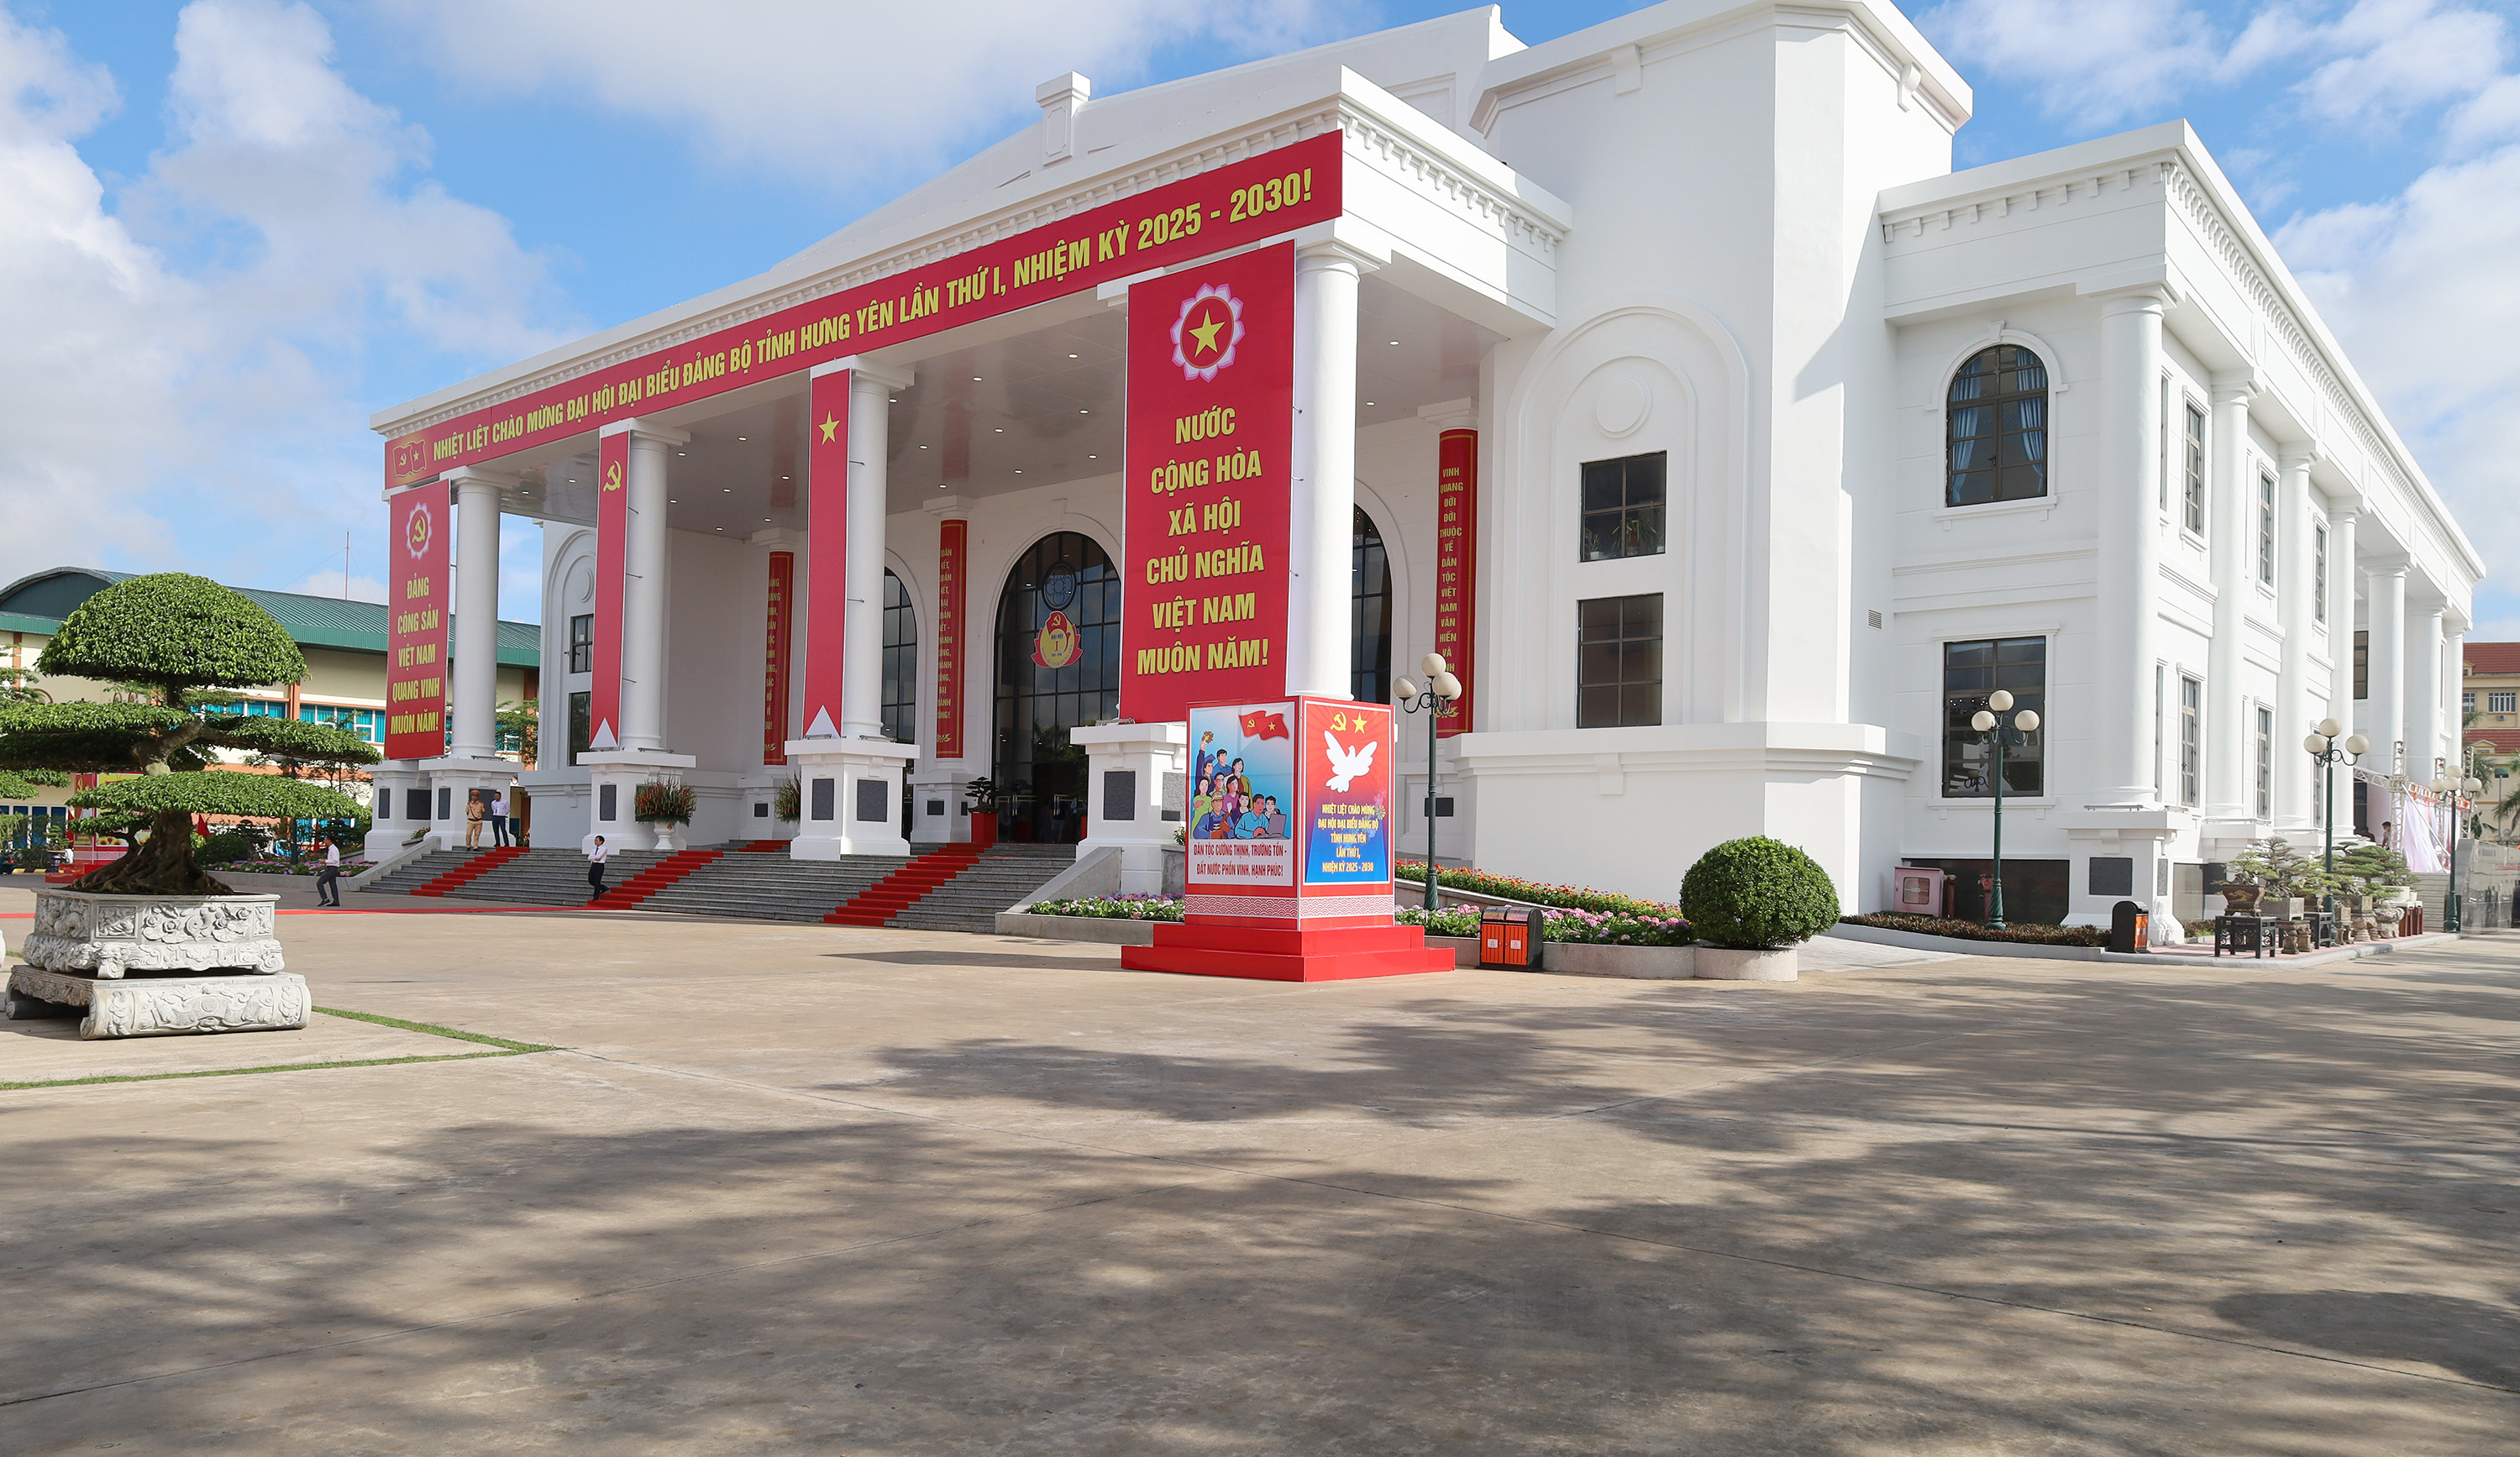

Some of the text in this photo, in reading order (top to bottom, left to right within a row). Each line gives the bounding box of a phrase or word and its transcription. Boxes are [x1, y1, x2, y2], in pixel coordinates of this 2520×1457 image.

[433, 168, 1312, 462] NHIỆT LIỆT CHÀO MỪNG ĐẠI HỘI ĐẠI BIỂU ĐẢNG BỘ TỈNH HƯNG YÊN LẦN THỨ I, NHIỆM KỲ 2025 - 2030!
[1175, 405, 1236, 445] NƯỚC
[1151, 446, 1263, 496] CỘNG HÒA
[1442, 467, 1460, 478] VINH
[1440, 482, 1464, 494] QUANG
[1444, 495, 1457, 507] ĐỜI
[1168, 496, 1241, 537] XÃ HỘI
[1443, 511, 1456, 522] ĐỜI
[1440, 526, 1462, 538] THUỘC
[1146, 540, 1264, 585] CHỦ NGHĨA
[1441, 556, 1457, 568] DÂN
[1442, 571, 1456, 584] TỘC
[407, 573, 429, 600] ĐẢNG
[1441, 587, 1457, 599] VIỆT
[1152, 592, 1256, 632] VIỆT NAM
[1440, 602, 1457, 612] NAM
[397, 603, 438, 637] CỘNG SẢN
[1441, 616, 1456, 627] VĂN
[1439, 631, 1457, 642] HIẾN
[398, 643, 436, 671] VIỆT NAM
[1137, 636, 1268, 675] MUÔN NĂM!
[1442, 646, 1452, 657] VÀ
[392, 677, 440, 704] QUANG VINH
[390, 708, 438, 735] MUÔN NĂM!
[1194, 842, 1204, 855] DÂN
[1205, 842, 1215, 857] TỘC
[1215, 841, 1232, 856] CƯỜNG
[1234, 845, 1250, 858] THỊNH,
[1252, 842, 1272, 856] TRƯỜNG
[1197, 860, 1206, 874] ĐẤT
[1207, 862, 1221, 875] NƯỚC
[1237, 864, 1250, 877] VINH,
[1252, 864, 1266, 878] HẠNH
[1267, 862, 1283, 876] PHÚC!
